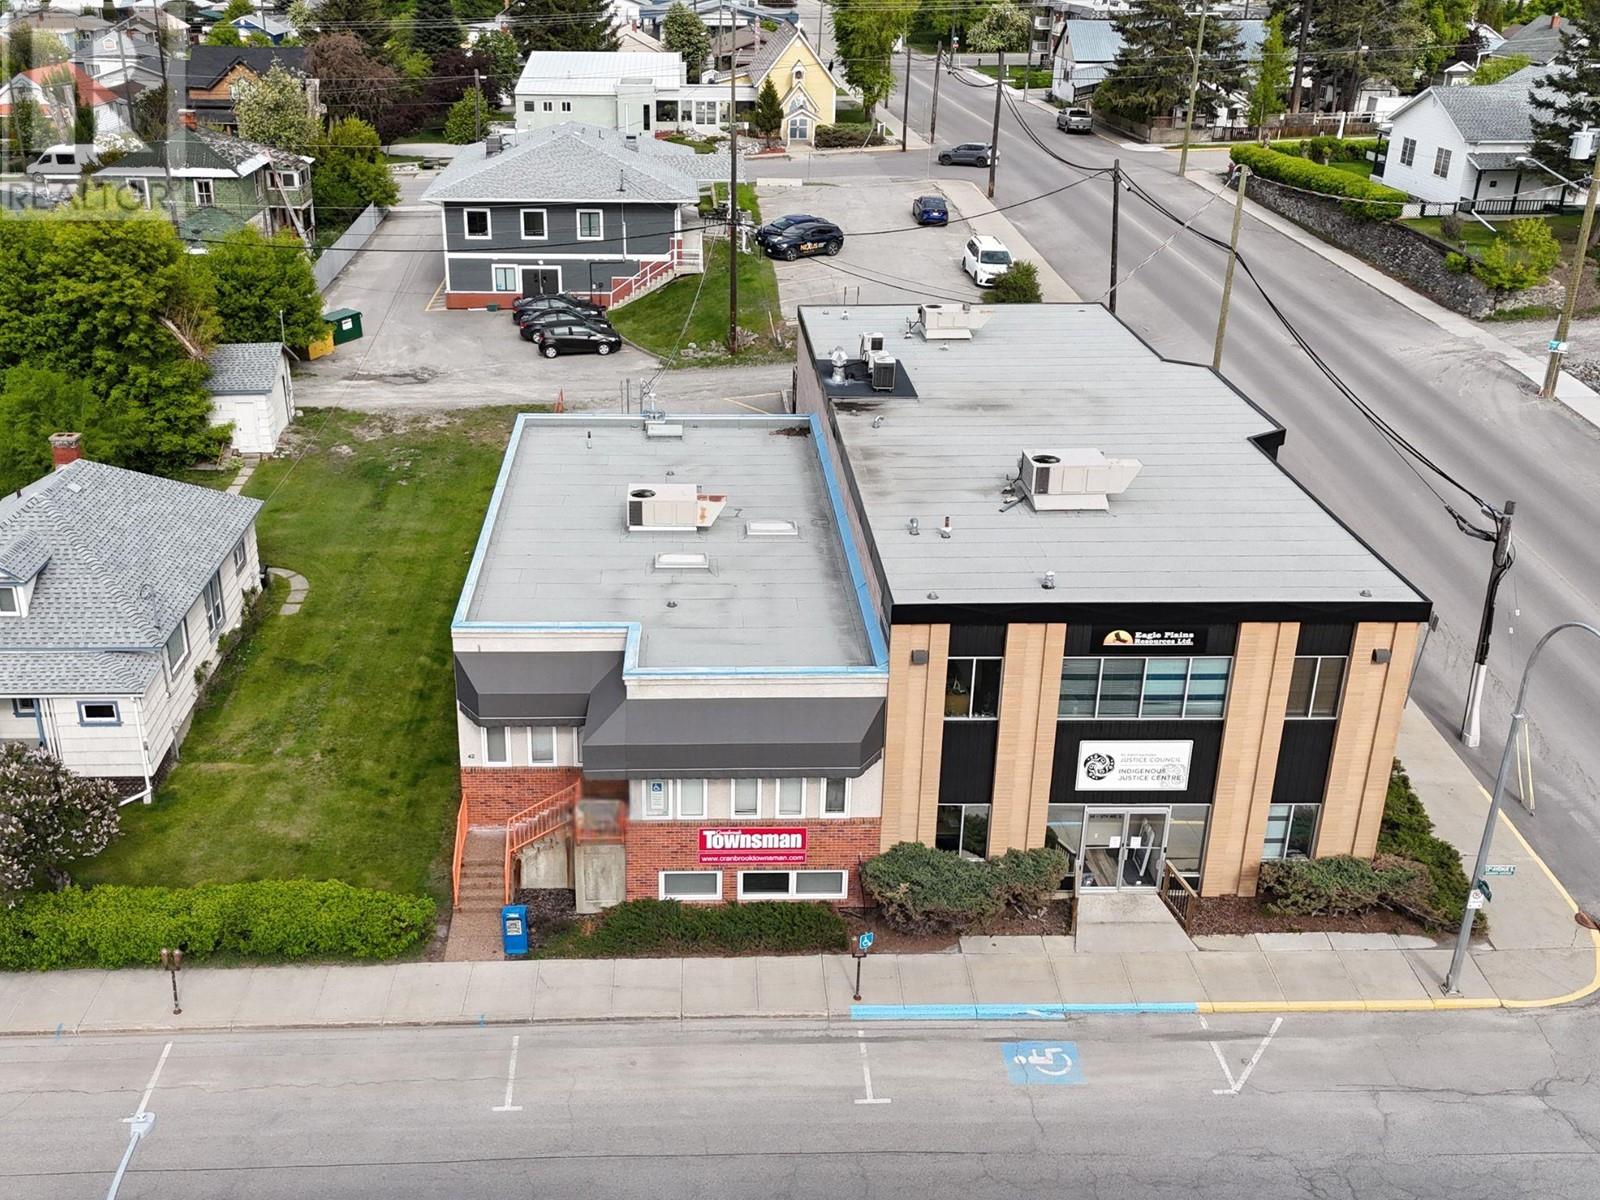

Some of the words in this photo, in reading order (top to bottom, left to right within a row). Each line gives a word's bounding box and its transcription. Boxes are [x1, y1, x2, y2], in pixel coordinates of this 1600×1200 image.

[1134, 631, 1162, 640] Eagle
[1164, 631, 1195, 639] Plains
[1134, 638, 1175, 646] Resources
[702, 829, 803, 849] Townsman
